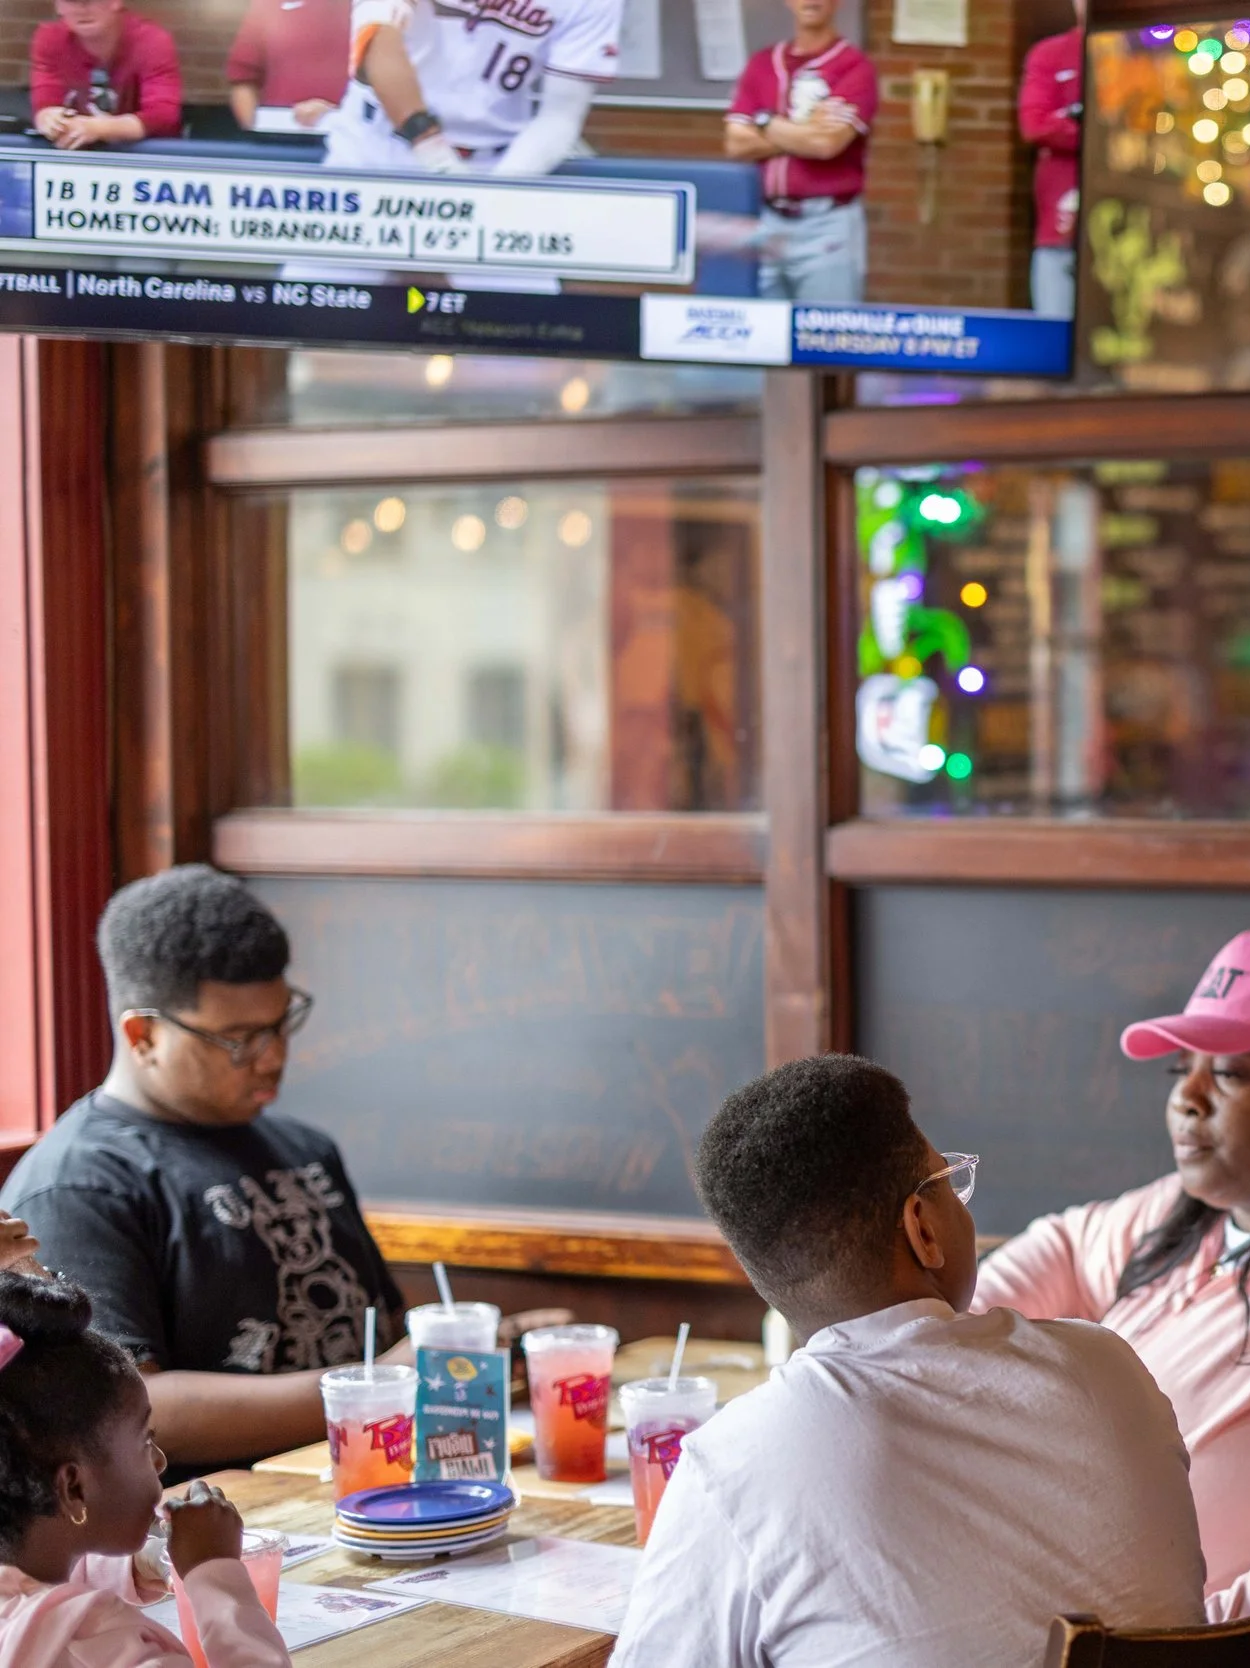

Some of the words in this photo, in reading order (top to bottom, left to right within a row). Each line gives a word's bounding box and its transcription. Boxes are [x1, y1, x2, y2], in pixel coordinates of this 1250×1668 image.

[481, 41, 532, 92] 18
[91, 181, 121, 203] 18
[133, 180, 212, 207] SAM
[230, 185, 360, 214] HARRIS
[372, 196, 475, 221] JUNIOR
[46, 209, 220, 236] HOMETOWN:
[230, 219, 371, 248] URBANDALE,
[379, 226, 402, 247] IA
[493, 231, 532, 254] 220
[77, 273, 141, 298] North
[144, 277, 236, 304] Carolina
[242, 285, 266, 304] vs
[273, 283, 307, 307] NC
[311, 285, 372, 310] State
[441, 291, 467, 314] ET
[795, 330, 900, 355] THURSDAY
[1200, 967, 1245, 999] AT
